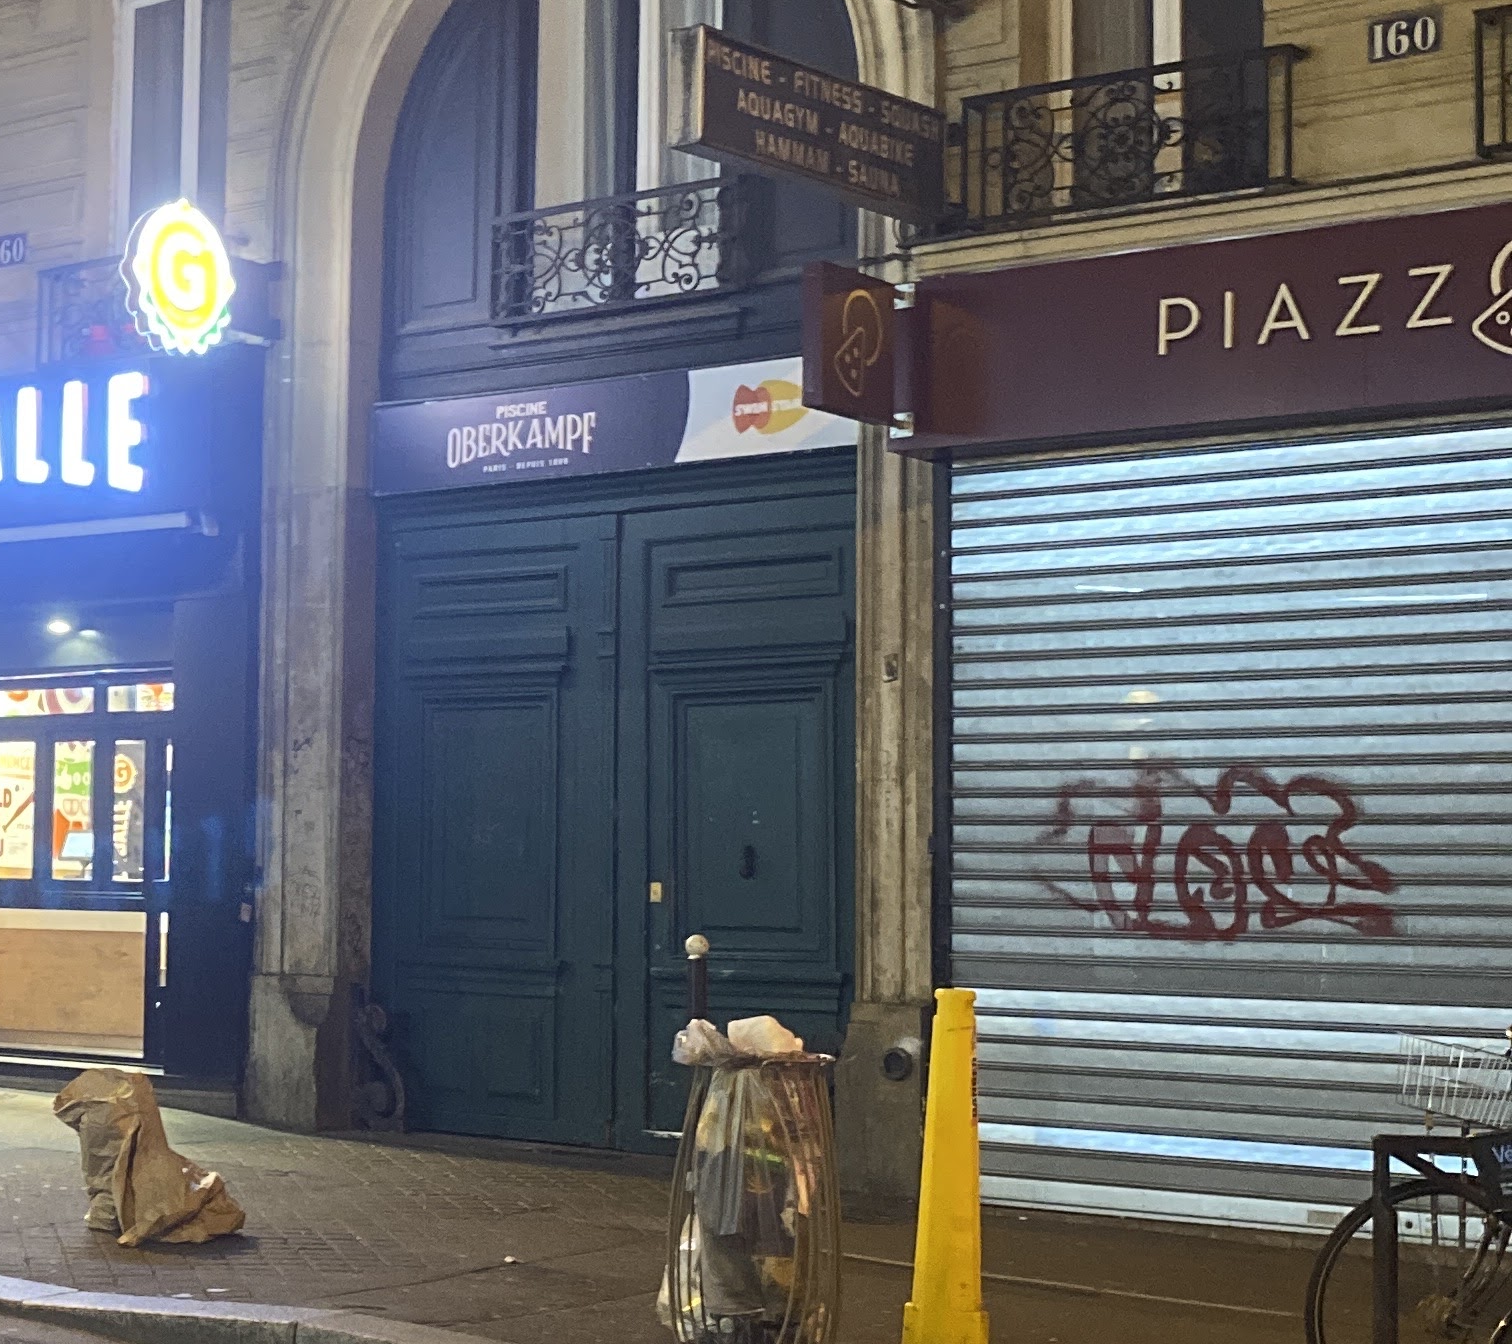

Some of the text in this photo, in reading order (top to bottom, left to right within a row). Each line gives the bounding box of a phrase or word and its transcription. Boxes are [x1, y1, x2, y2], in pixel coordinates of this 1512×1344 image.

[1372, 16, 1437, 60] 160
[737, 88, 819, 136] AQUAGYM
[792, 71, 863, 114] FITNESS
[495, 401, 548, 420] PISCINE
[446, 411, 598, 470] OBERKAMPF
